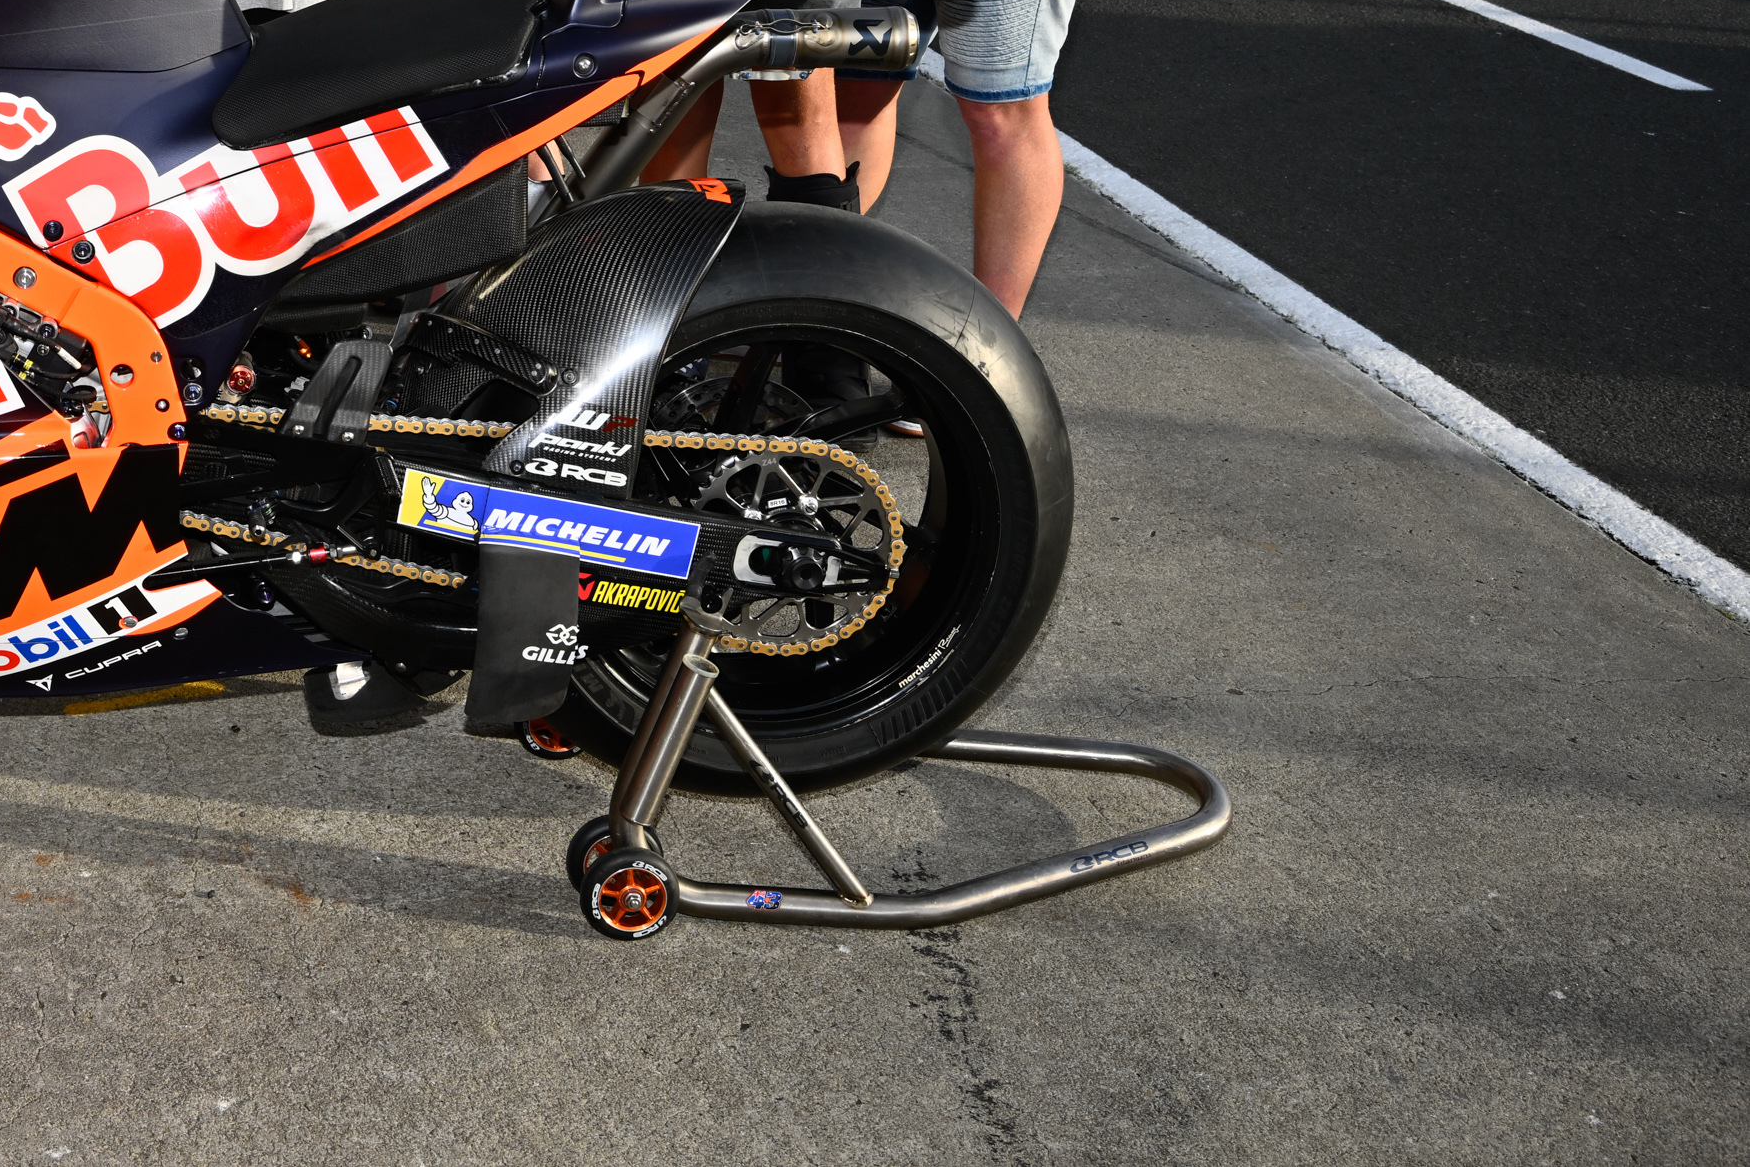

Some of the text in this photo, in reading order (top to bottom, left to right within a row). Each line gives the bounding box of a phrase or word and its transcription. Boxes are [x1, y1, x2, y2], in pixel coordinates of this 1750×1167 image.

[1, 104, 450, 329] Bull
[543, 446, 617, 463] RACING SYSTEMS
[561, 462, 628, 487] RCB
[484, 507, 672, 557] MICHELIN
[65, 640, 163, 680] CUPRA
[898, 646, 943, 689] marchesini
[769, 781, 809, 829] RCB
[1092, 840, 1149, 866] RCB
[746, 890, 783, 911] 43
